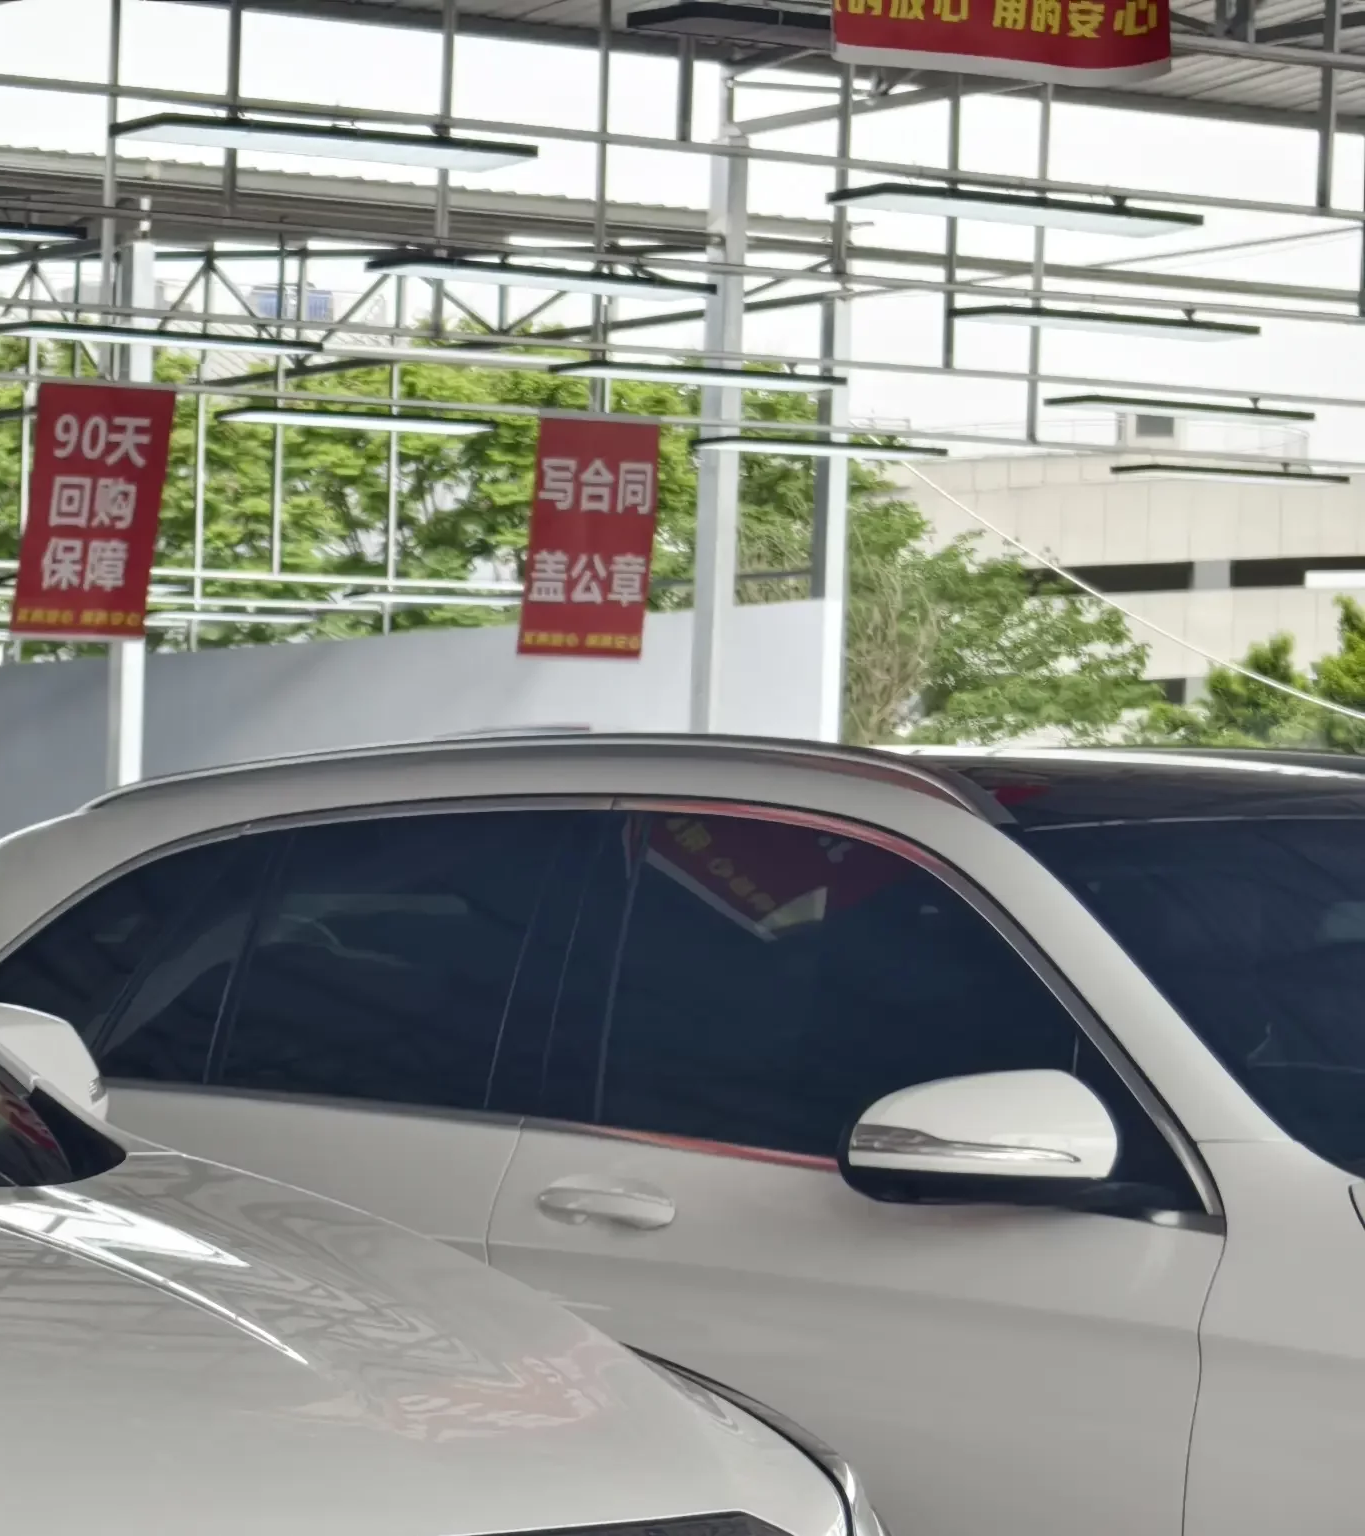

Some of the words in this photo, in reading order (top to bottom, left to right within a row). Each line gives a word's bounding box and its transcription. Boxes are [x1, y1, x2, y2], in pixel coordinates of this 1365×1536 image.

[835, 0, 968, 22] 的放心
[992, 1, 1157, 38] 用的安心
[53, 414, 152, 468] 90天
[49, 475, 137, 529] 回购
[538, 457, 653, 515] 写合同
[41, 537, 129, 592] 保障
[528, 550, 646, 607] 盖公章
